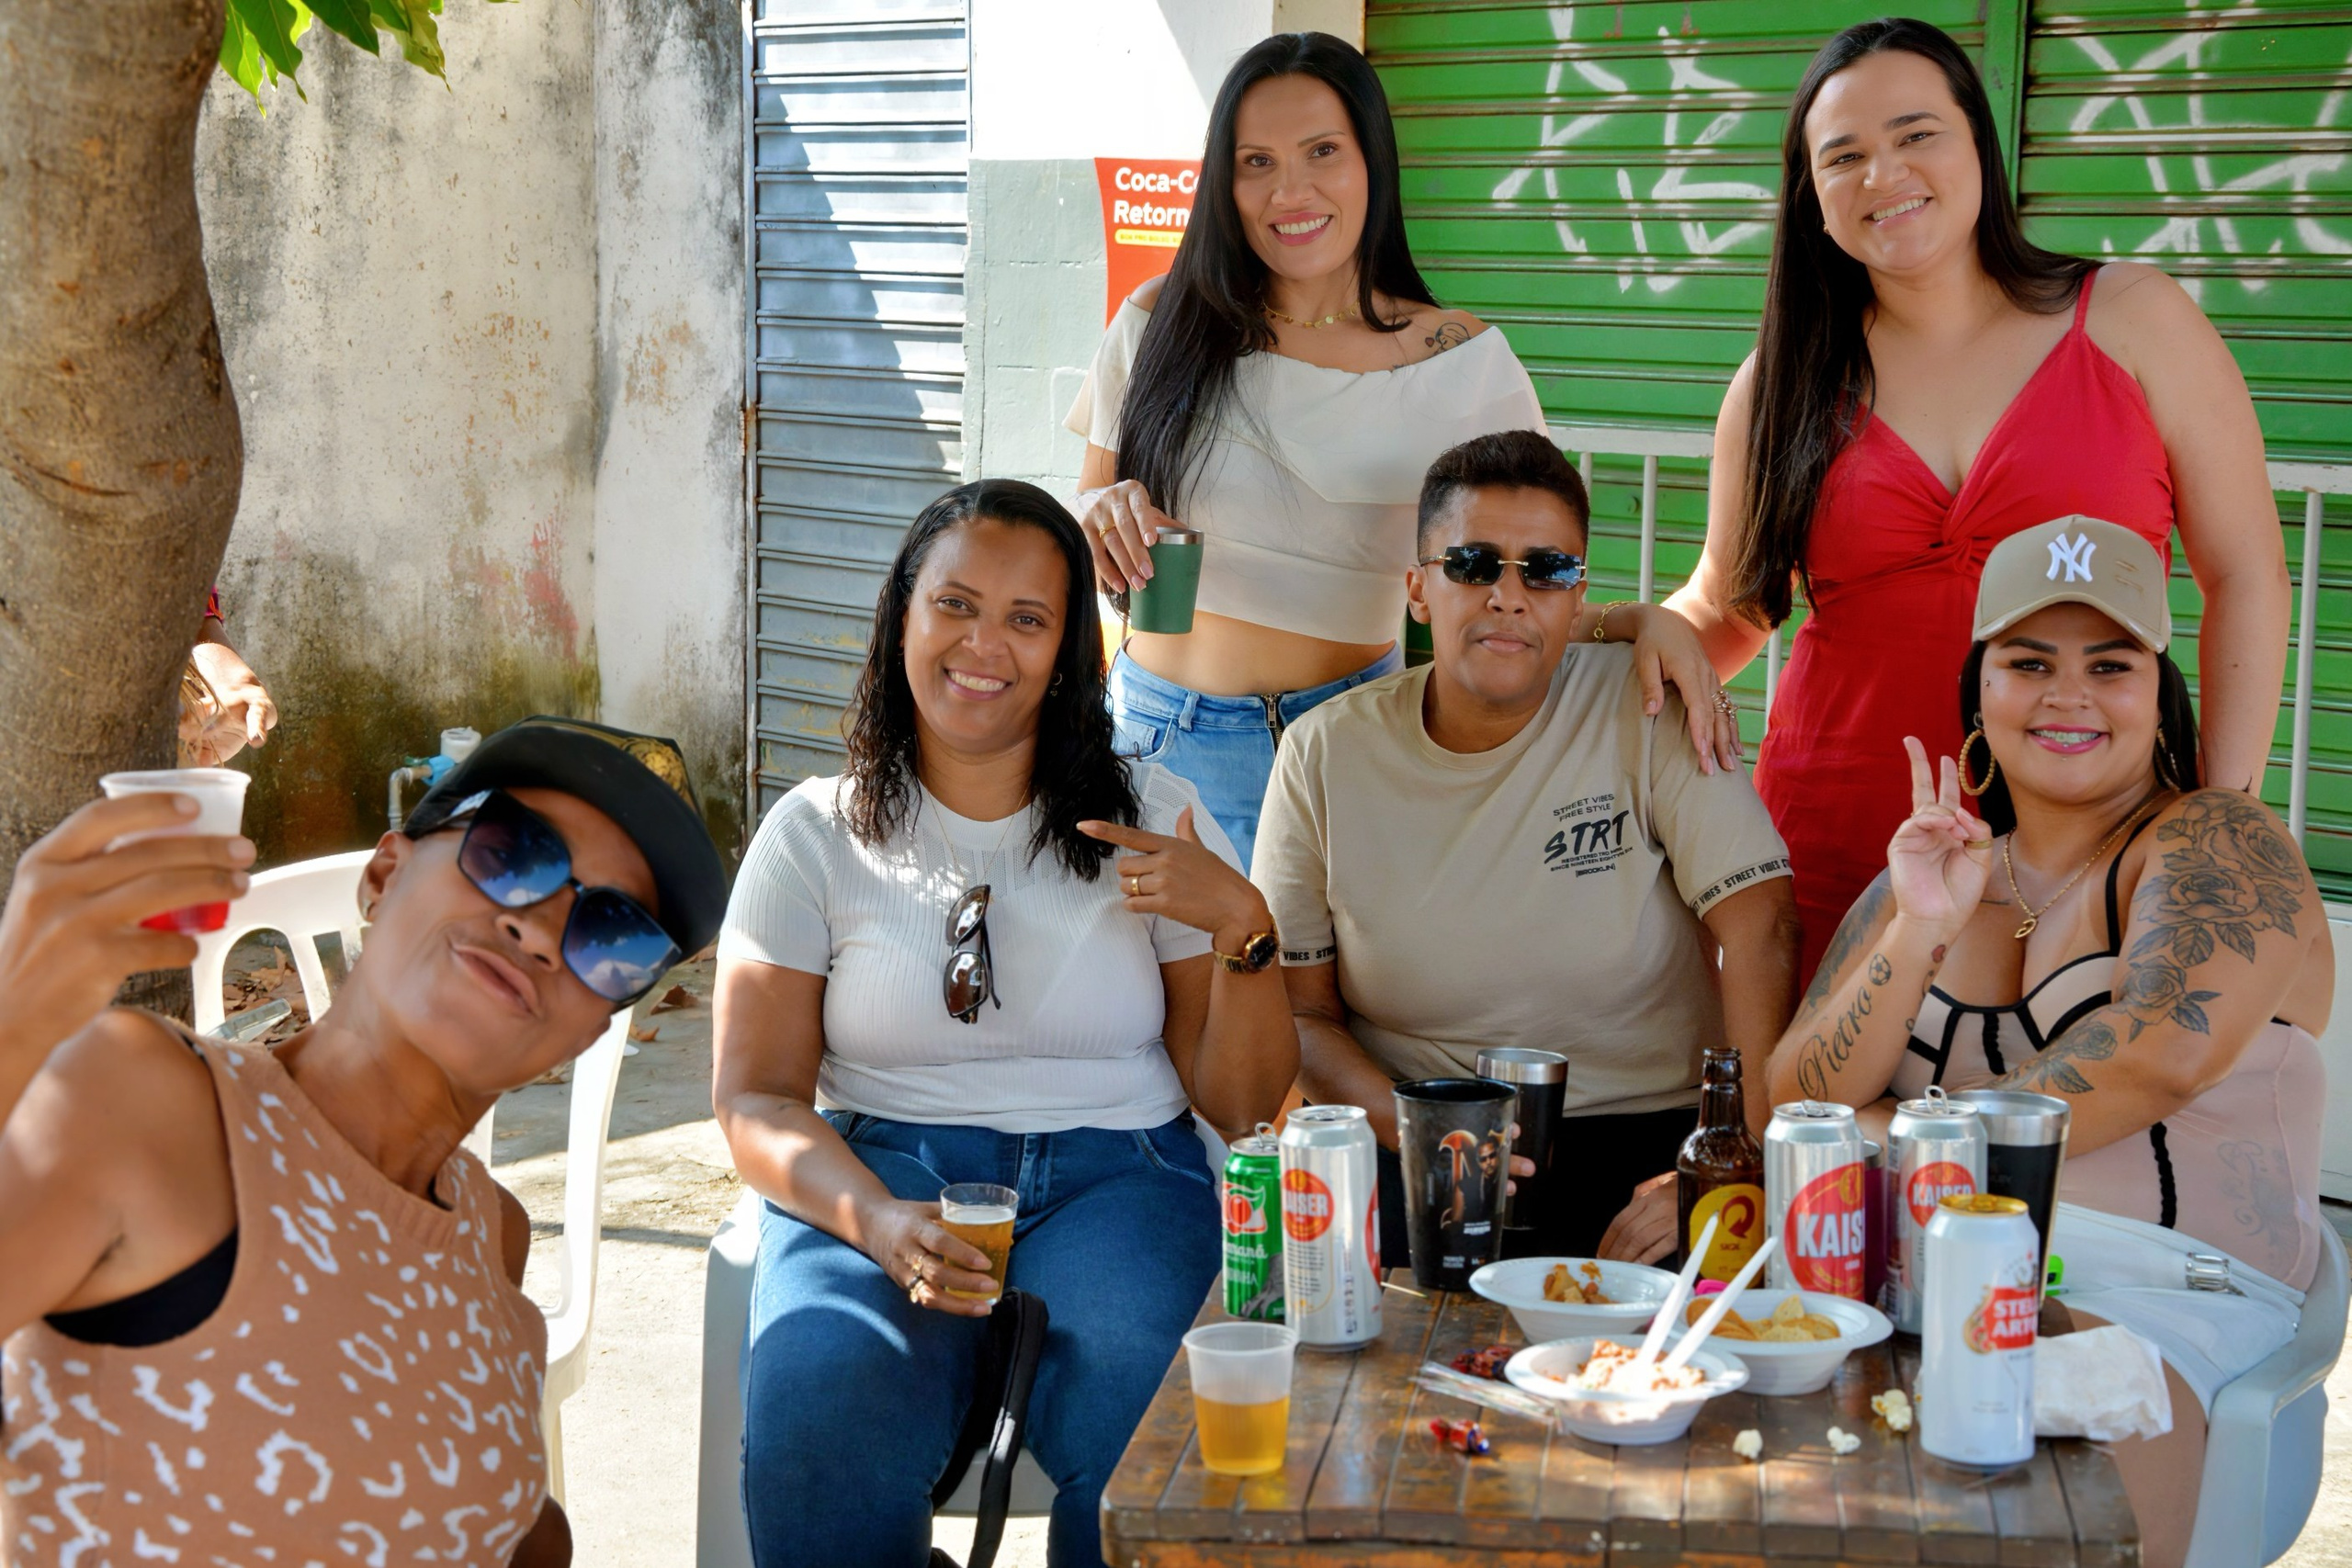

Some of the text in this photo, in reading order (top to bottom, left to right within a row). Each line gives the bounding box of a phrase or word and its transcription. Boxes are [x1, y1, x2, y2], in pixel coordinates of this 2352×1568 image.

[2046, 533, 2097, 582] NY
[1553, 794, 1615, 817] STREET VIBES
[1559, 803, 1611, 822] FREE STYLE
[1544, 809, 1630, 864] STRT
[1698, 885, 1722, 905] VIBES
[1724, 867, 1757, 888] STREET
[1758, 860, 1781, 874] VIBES
[1283, 950, 1310, 961] VIBES
